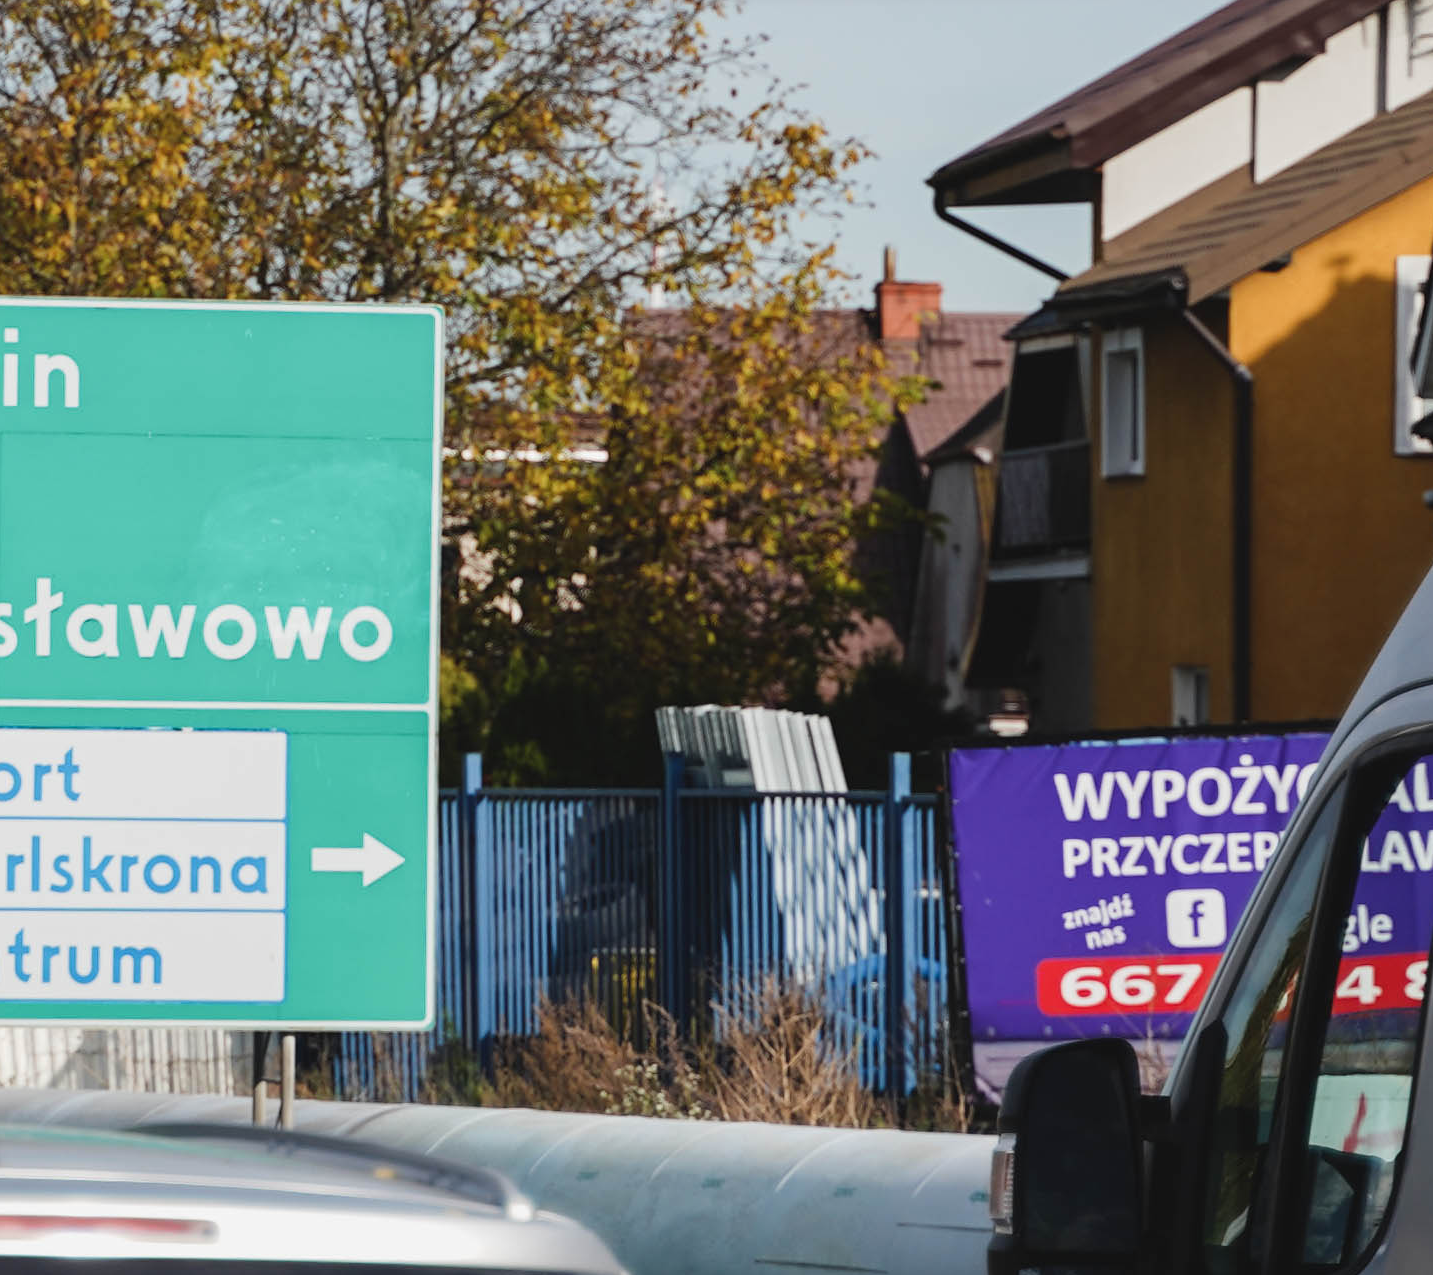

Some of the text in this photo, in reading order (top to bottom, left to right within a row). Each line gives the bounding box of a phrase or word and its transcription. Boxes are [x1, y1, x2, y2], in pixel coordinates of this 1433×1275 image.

[1063, 830, 1285, 878] PRZYCZEP
[1062, 893, 1135, 930] znajdź
[1085, 925, 1127, 950] nas
[1061, 964, 1203, 1007] 667
